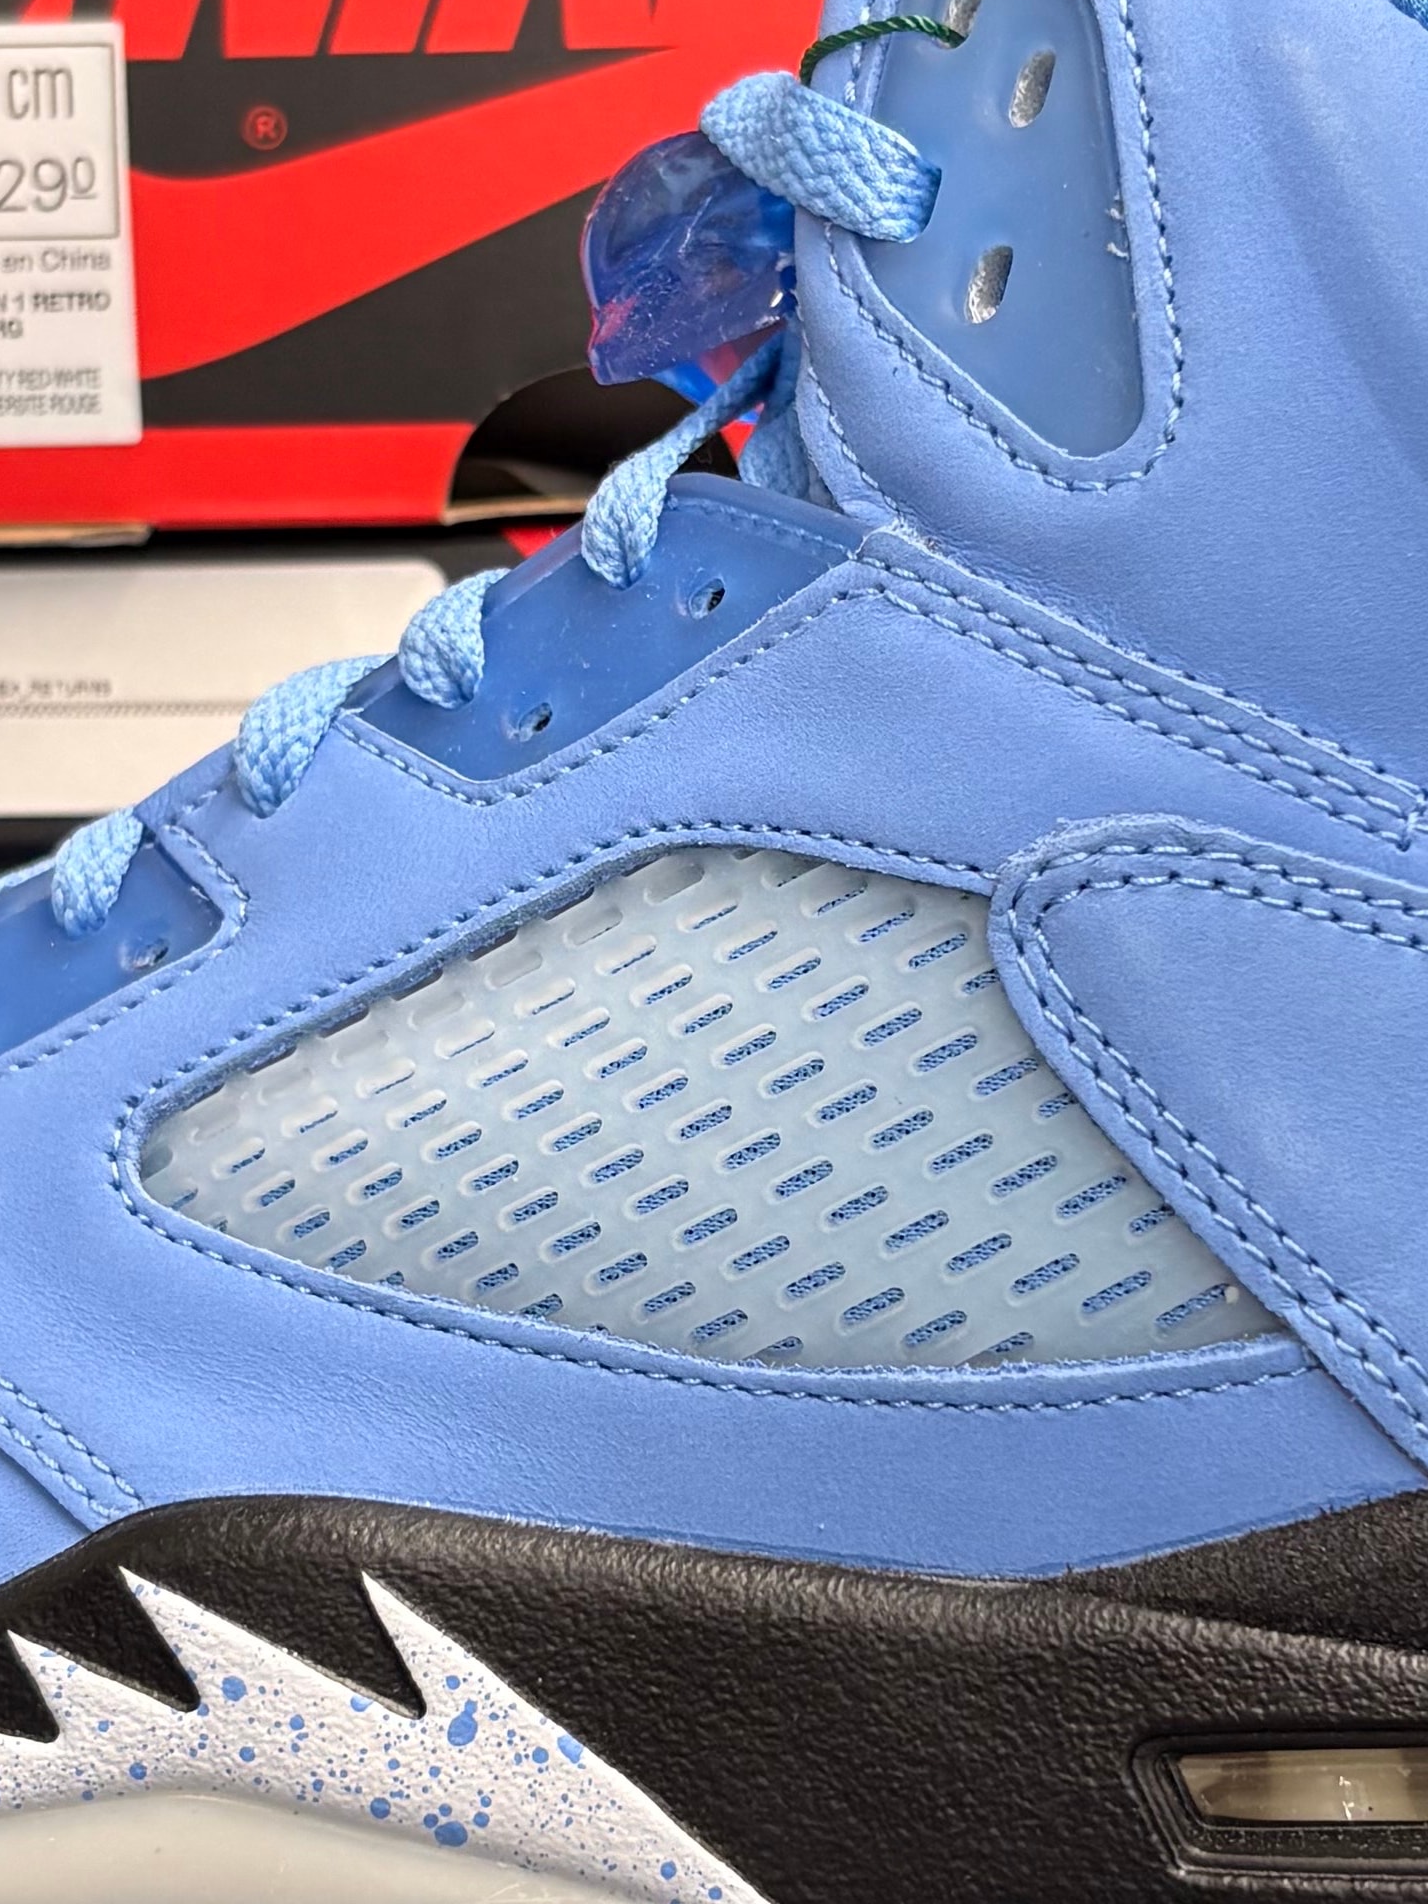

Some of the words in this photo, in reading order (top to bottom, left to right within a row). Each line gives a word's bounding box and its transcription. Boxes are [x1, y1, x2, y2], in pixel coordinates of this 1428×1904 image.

[7, 67, 74, 120] cm
[2, 255, 33, 274] en
[39, 247, 112, 272] China
[14, 293, 25, 312] 1
[33, 292, 112, 312] RETRO
